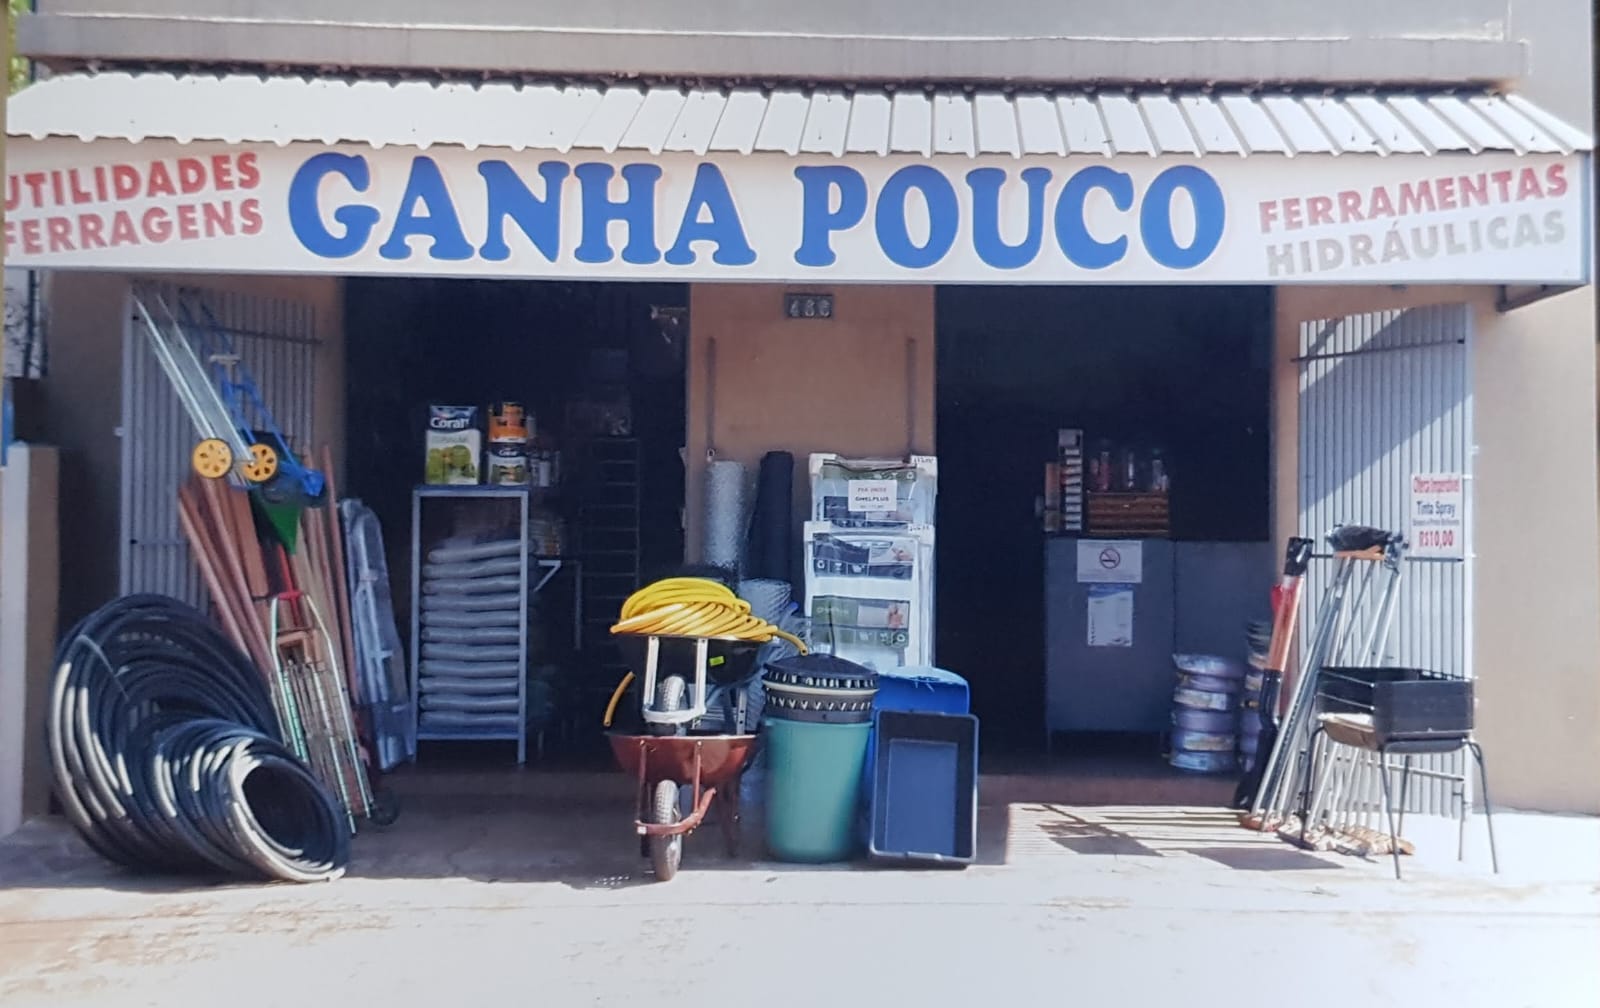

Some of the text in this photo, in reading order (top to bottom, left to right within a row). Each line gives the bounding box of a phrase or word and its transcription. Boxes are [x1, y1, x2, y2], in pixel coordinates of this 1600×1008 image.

[288, 151, 1226, 270] GANHA POUCO
[1258, 163, 1568, 235] FERRAMENTAS
[1266, 209, 1566, 278] HIDRÁULICAS
[430, 416, 466, 429] Coral
[1416, 500, 1455, 518] Tinta Spray
